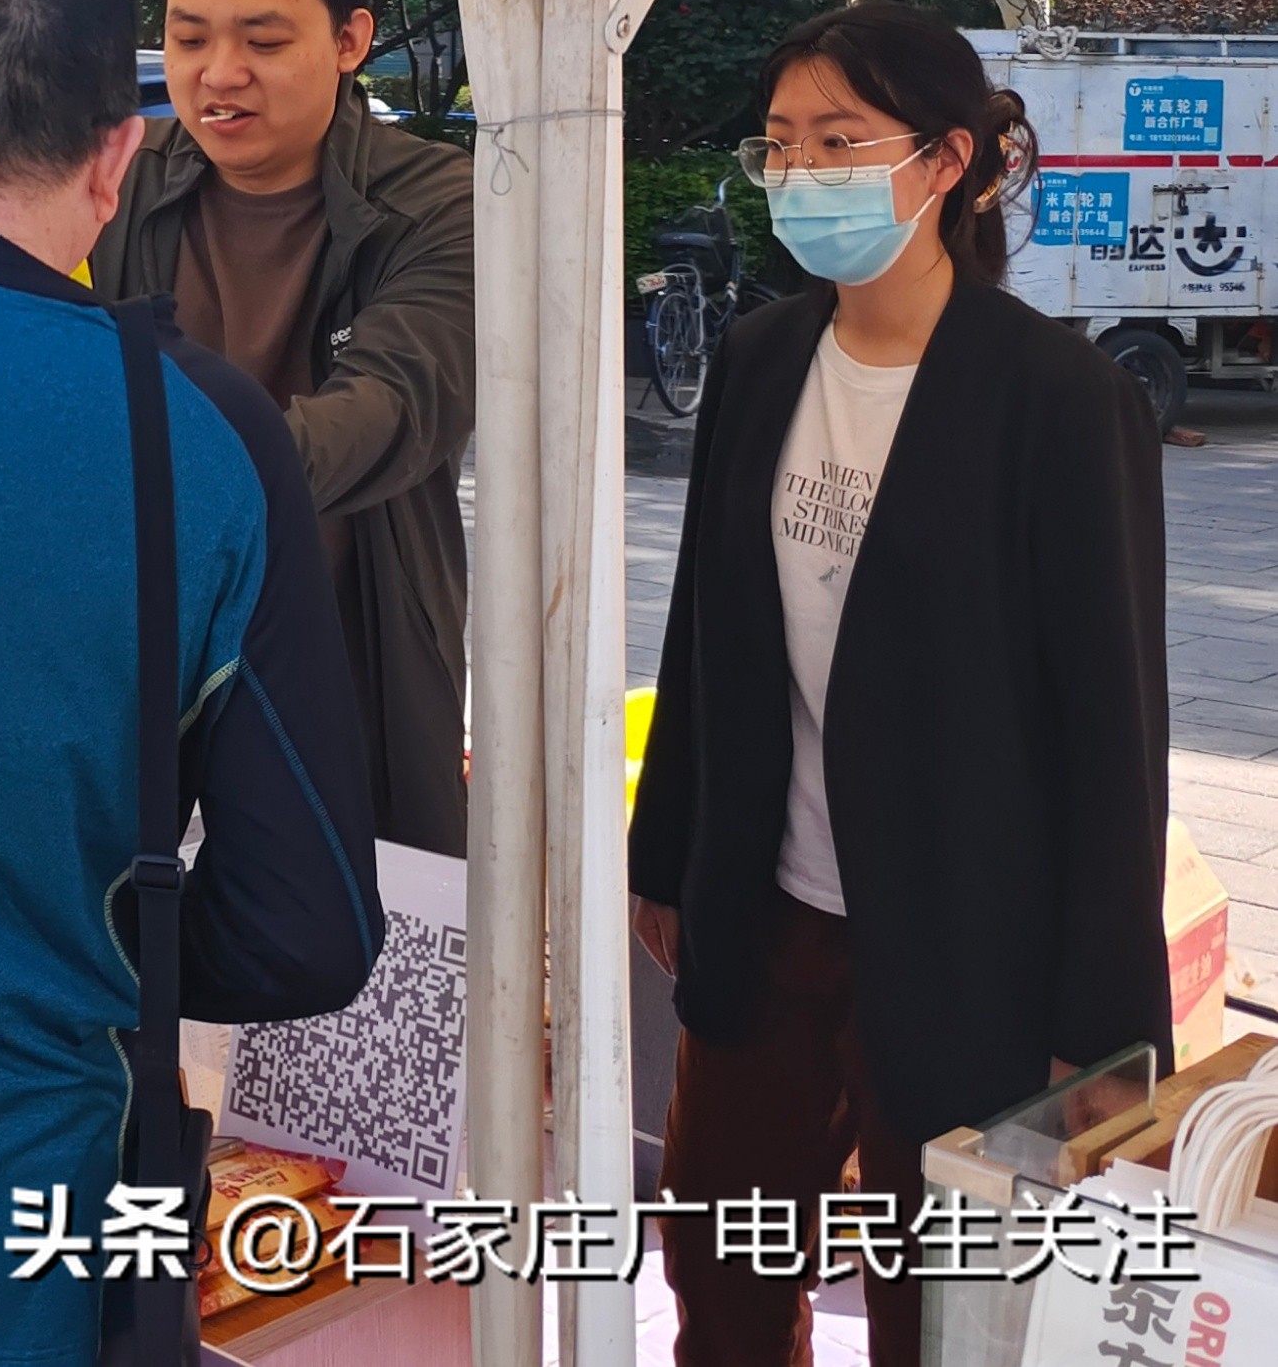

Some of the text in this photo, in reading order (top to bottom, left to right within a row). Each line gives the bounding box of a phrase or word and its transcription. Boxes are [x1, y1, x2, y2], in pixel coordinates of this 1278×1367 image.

[1141, 98, 1208, 115] 米高轮滑
[1144, 116, 1205, 129] 新合作广场
[1045, 191, 1114, 208] 米高轮滑
[820, 460, 877, 492] WHEN
[785, 472, 832, 505] THE
